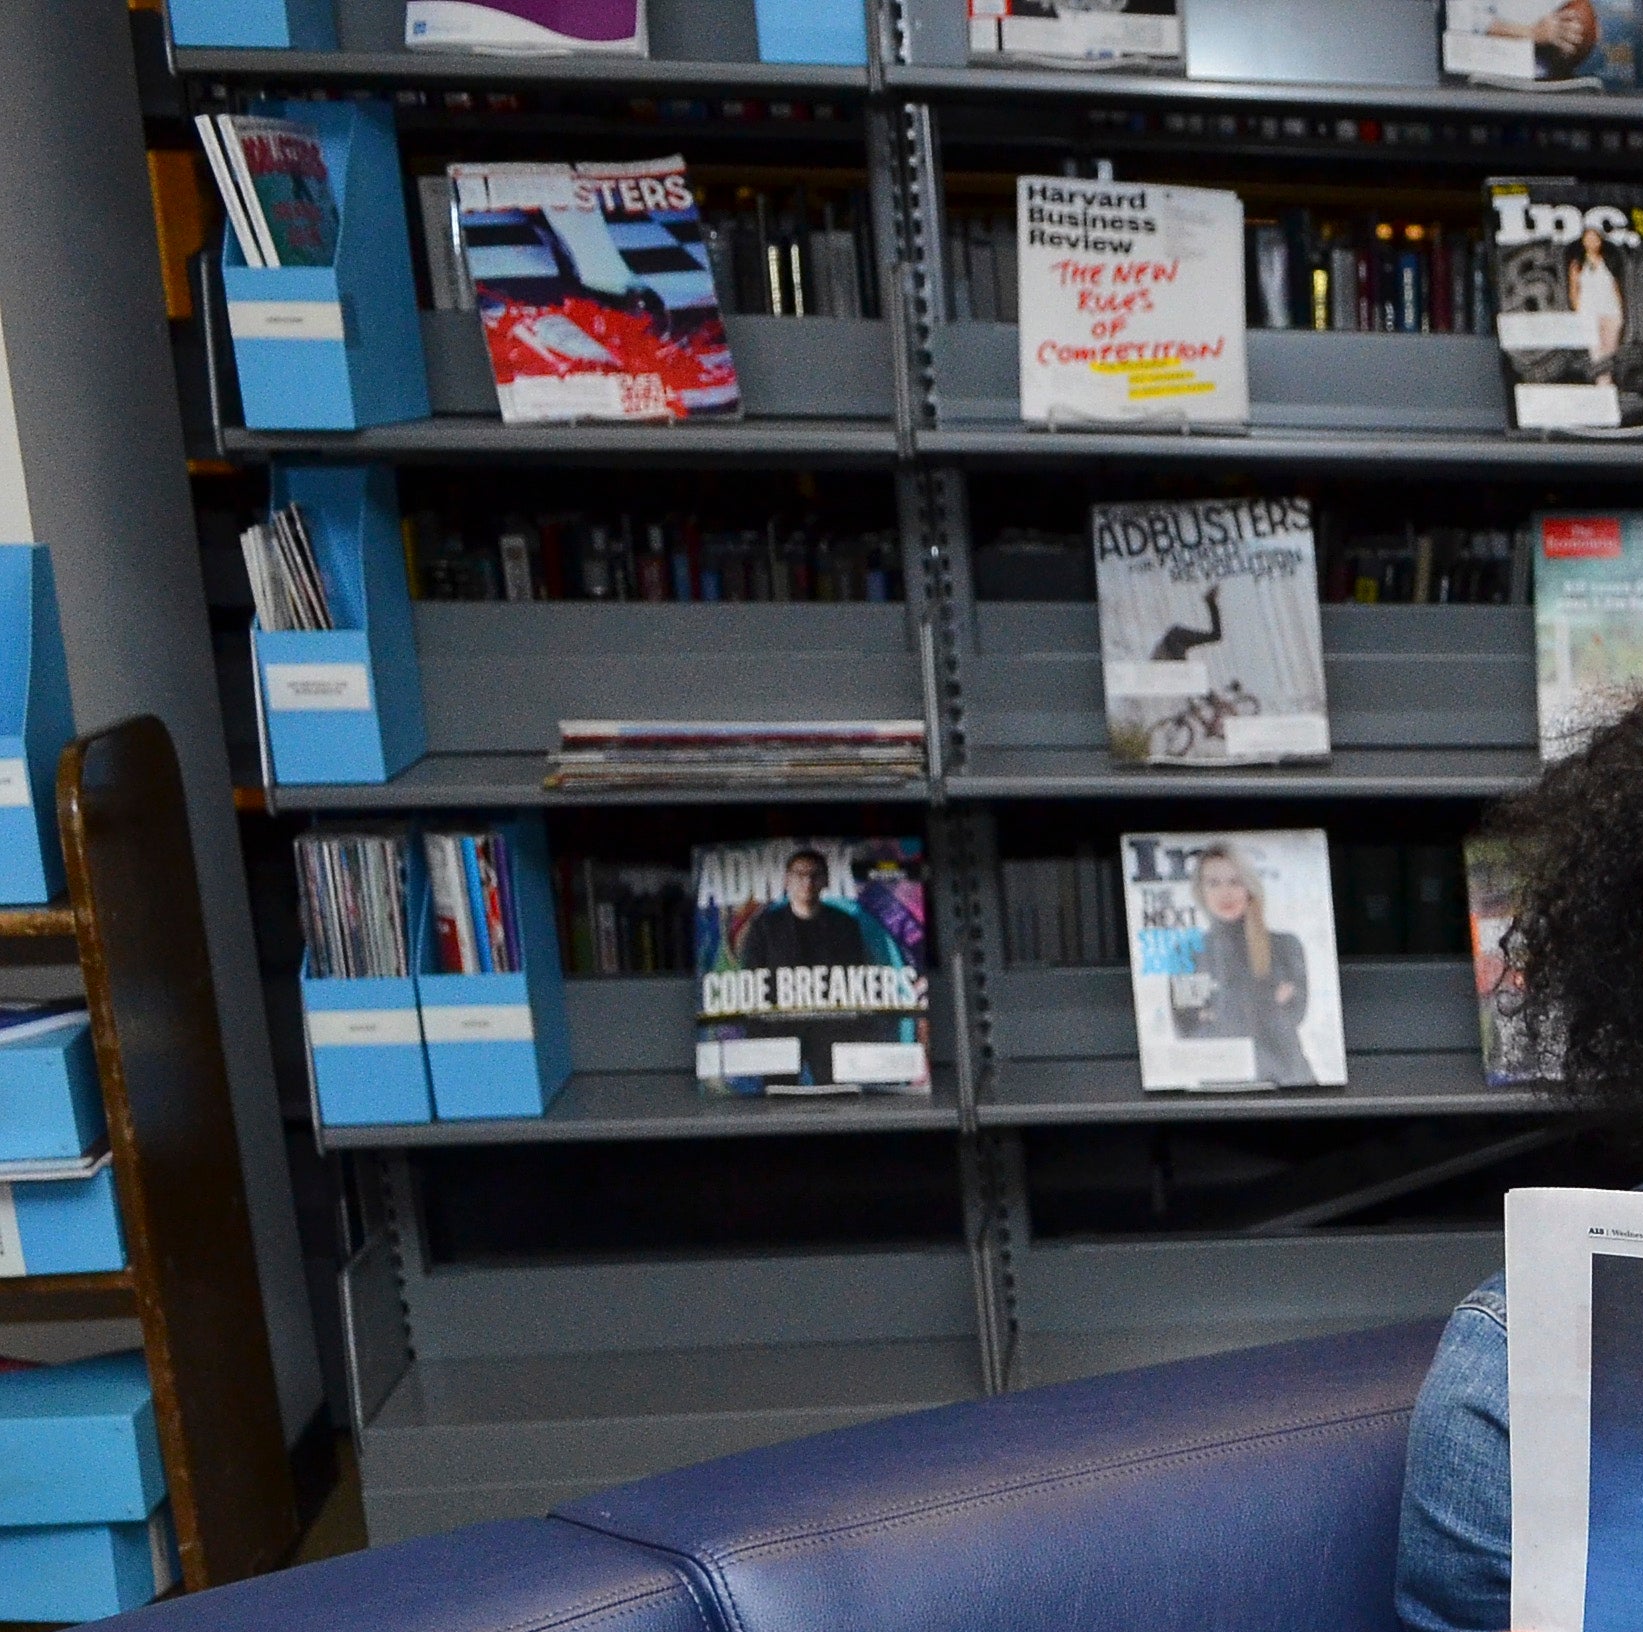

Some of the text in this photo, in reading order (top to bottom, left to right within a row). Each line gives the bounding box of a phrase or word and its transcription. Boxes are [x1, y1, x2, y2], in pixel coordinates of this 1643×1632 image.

[1027, 184, 1147, 209] Harvard
[1027, 207, 1156, 233] Business
[1492, 194, 1642, 248] Inc.
[1028, 228, 1132, 254] Review
[1052, 257, 1180, 285] THE NEW
[1077, 287, 1154, 312] RULES
[1090, 314, 1127, 339] OF
[1036, 336, 1226, 366] COMPETITION
[1098, 498, 1311, 562] ADBUSTERS
[697, 850, 858, 909] ADWK
[702, 965, 920, 1016] CODE BREAKERS
